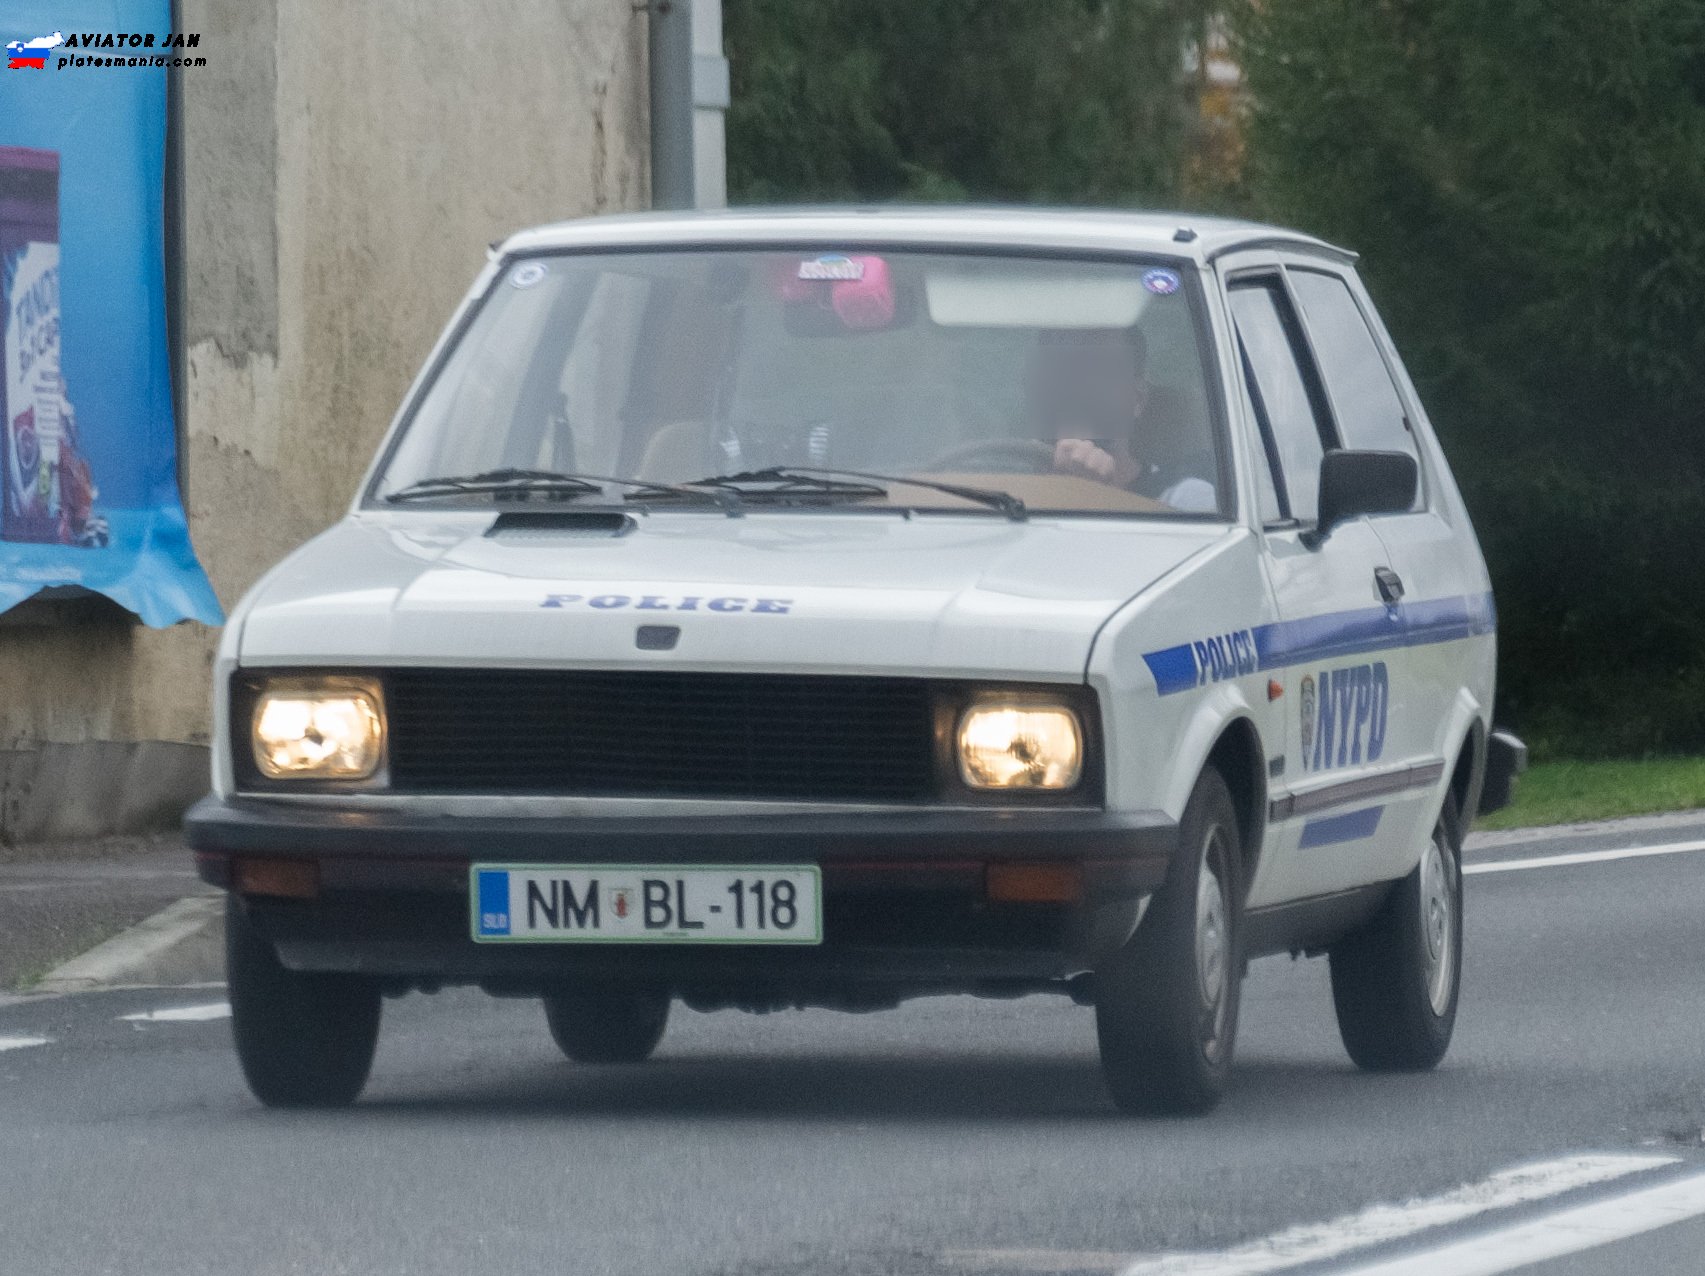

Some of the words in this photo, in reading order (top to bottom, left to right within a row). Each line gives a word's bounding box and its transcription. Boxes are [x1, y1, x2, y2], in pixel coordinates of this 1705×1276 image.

[539, 594, 794, 614] POLICE
[1193, 629, 1257, 687] POLICE
[1313, 661, 1389, 772] NYPD
[526, 879, 600, 930] NM
[642, 879, 798, 930] BL-118
